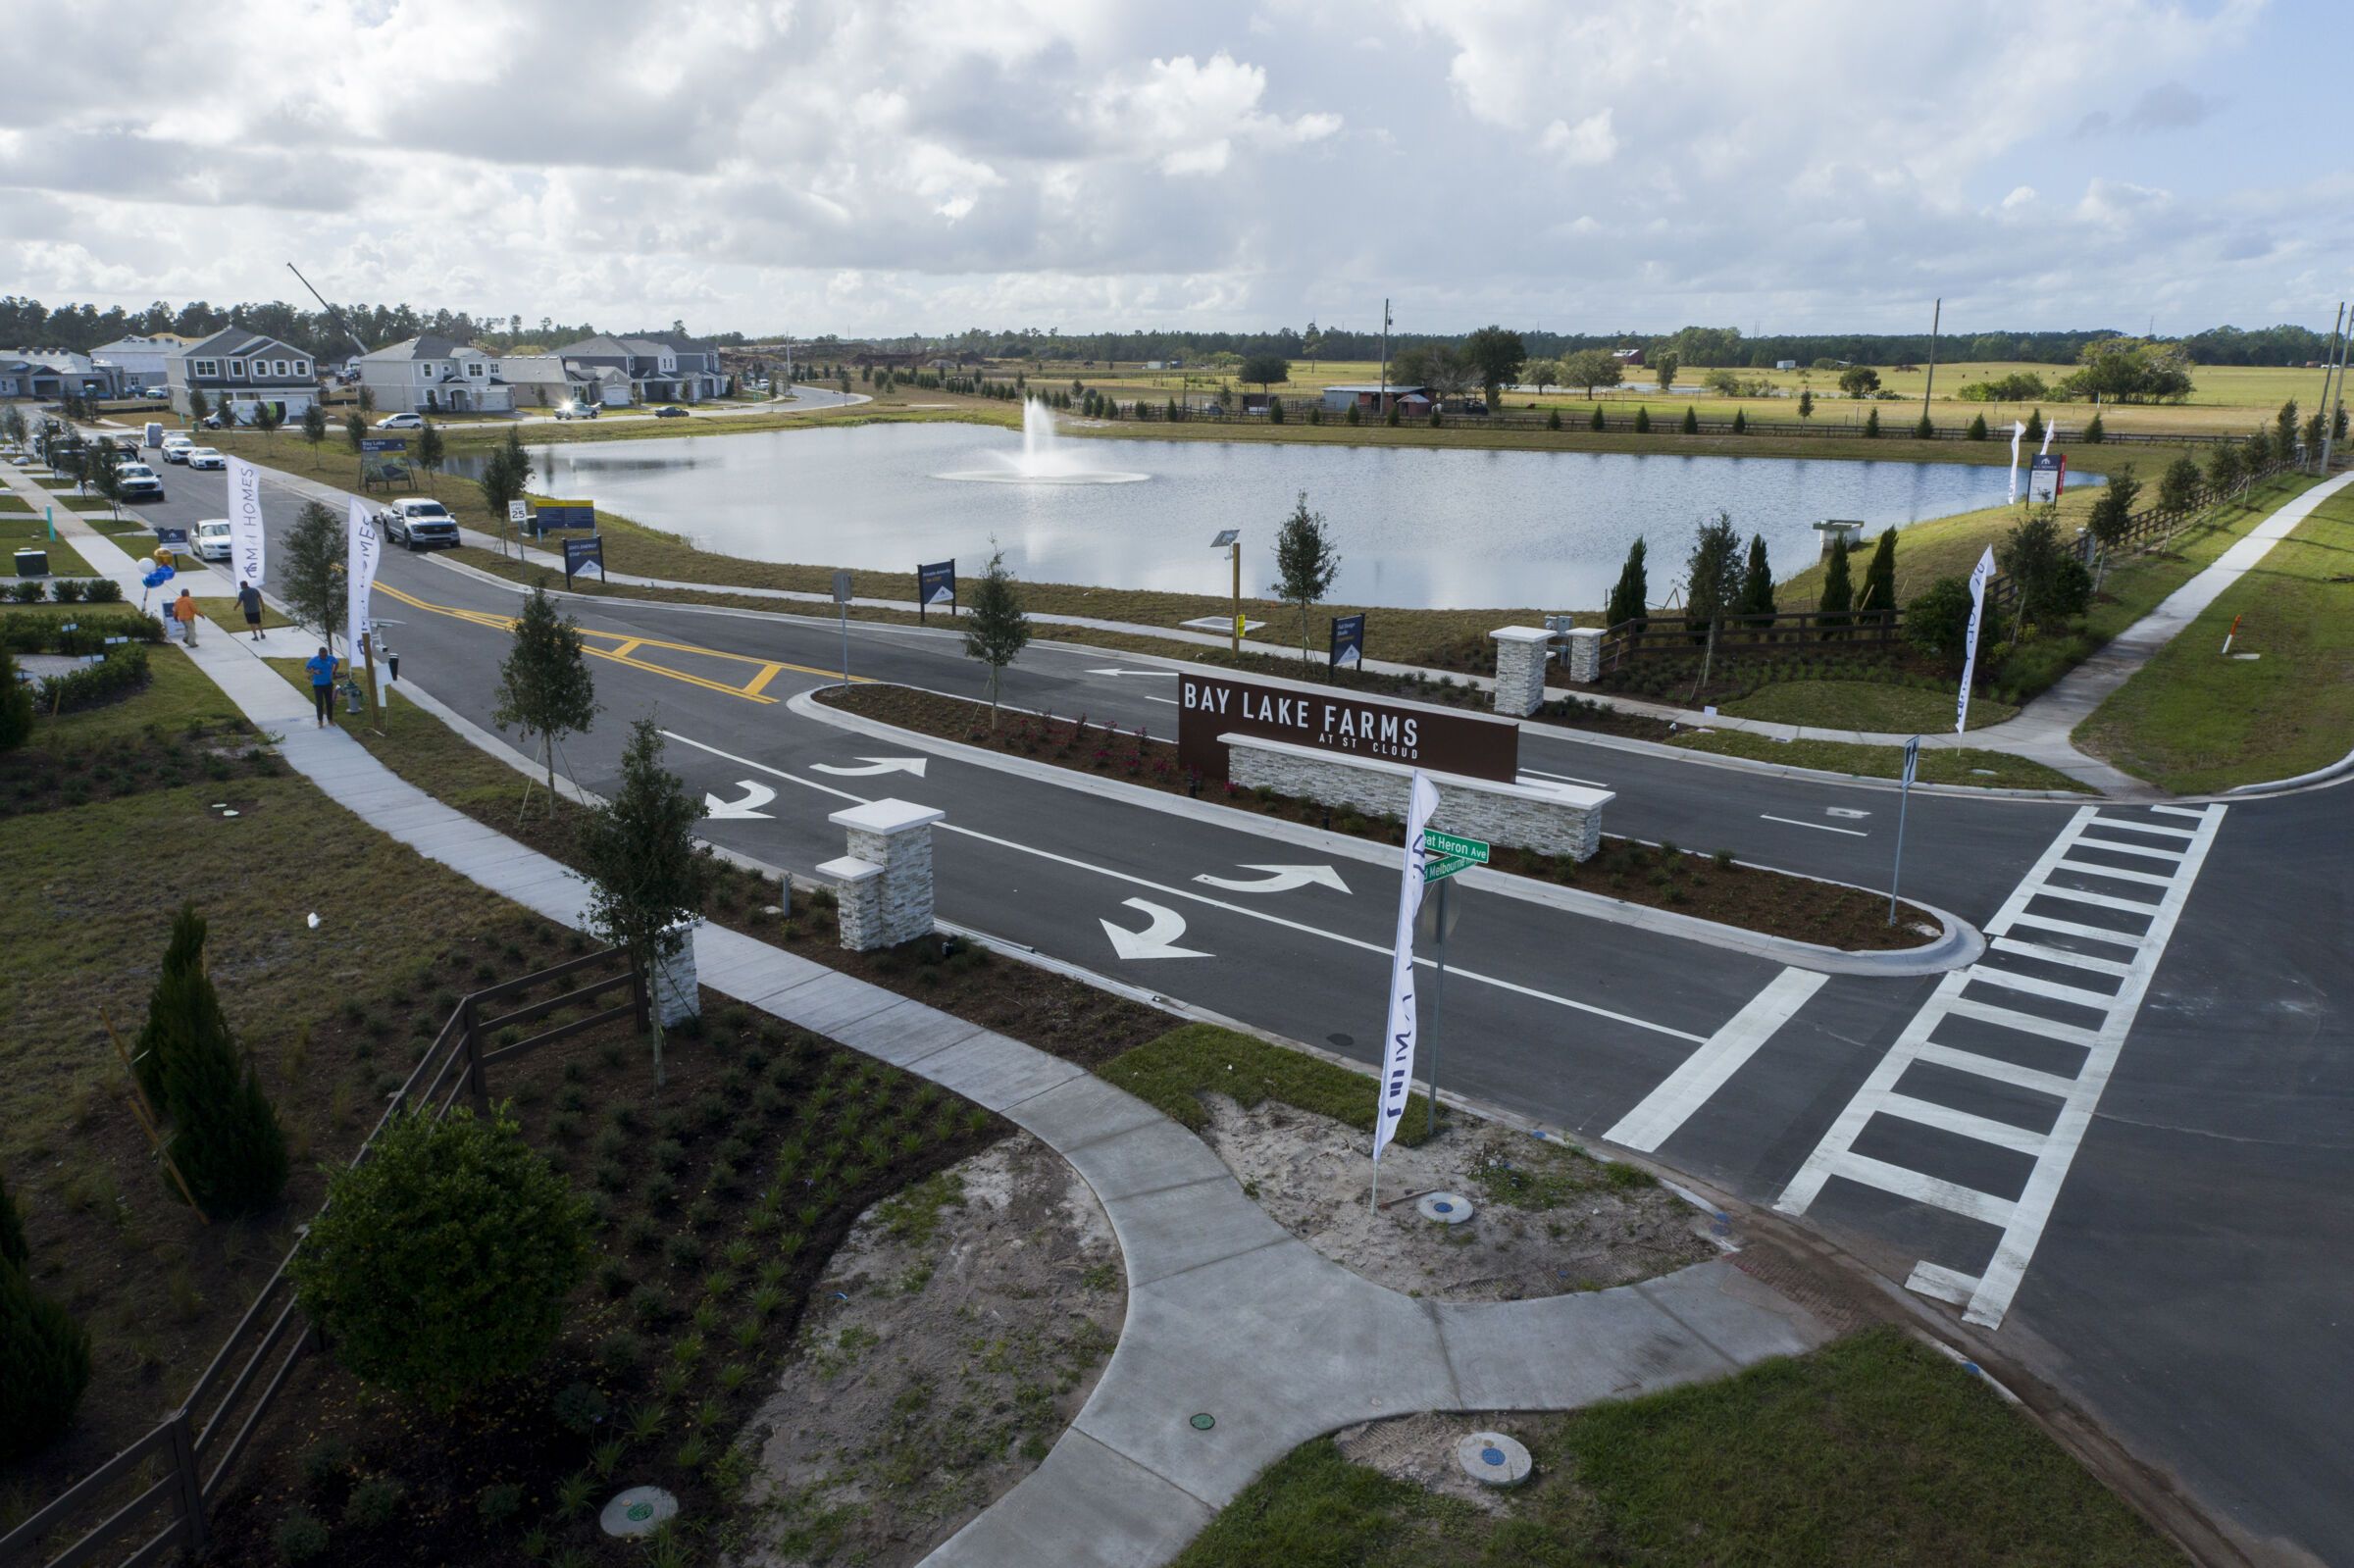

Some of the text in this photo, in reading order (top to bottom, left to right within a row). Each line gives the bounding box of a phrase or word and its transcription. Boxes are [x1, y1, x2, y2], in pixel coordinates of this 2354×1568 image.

[241, 468, 257, 527] HOMES
[512, 510, 526, 519] 25
[1184, 683, 1417, 747] BAY LAKE FARMS
[1318, 733, 1417, 760] AT ST CLOUD
[1438, 835, 1468, 855] Heron
[1470, 846, 1487, 859] Ave
[1429, 859, 1465, 879] Melbourne
